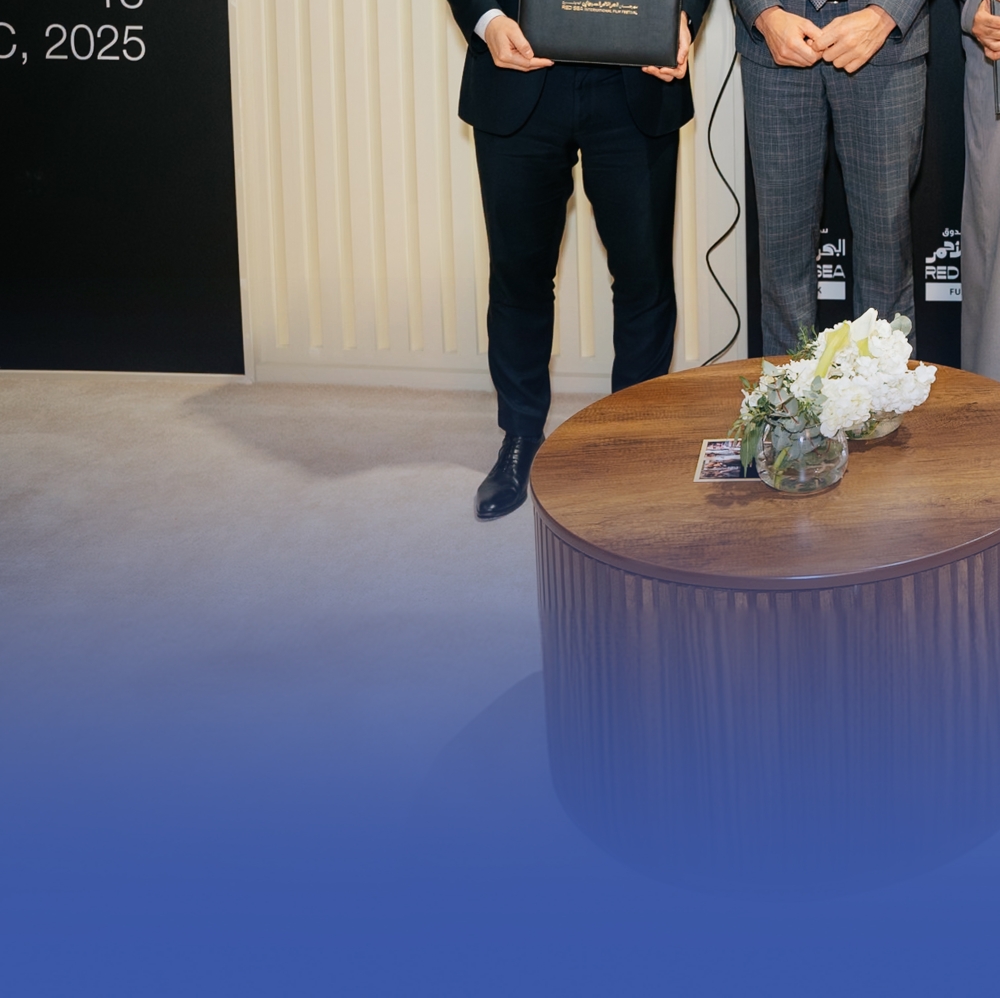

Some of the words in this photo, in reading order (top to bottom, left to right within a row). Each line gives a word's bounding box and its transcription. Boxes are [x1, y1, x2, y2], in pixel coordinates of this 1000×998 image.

[45, 23, 146, 62] 2025
[925, 266, 960, 280] RED
[949, 288, 961, 296] FU
